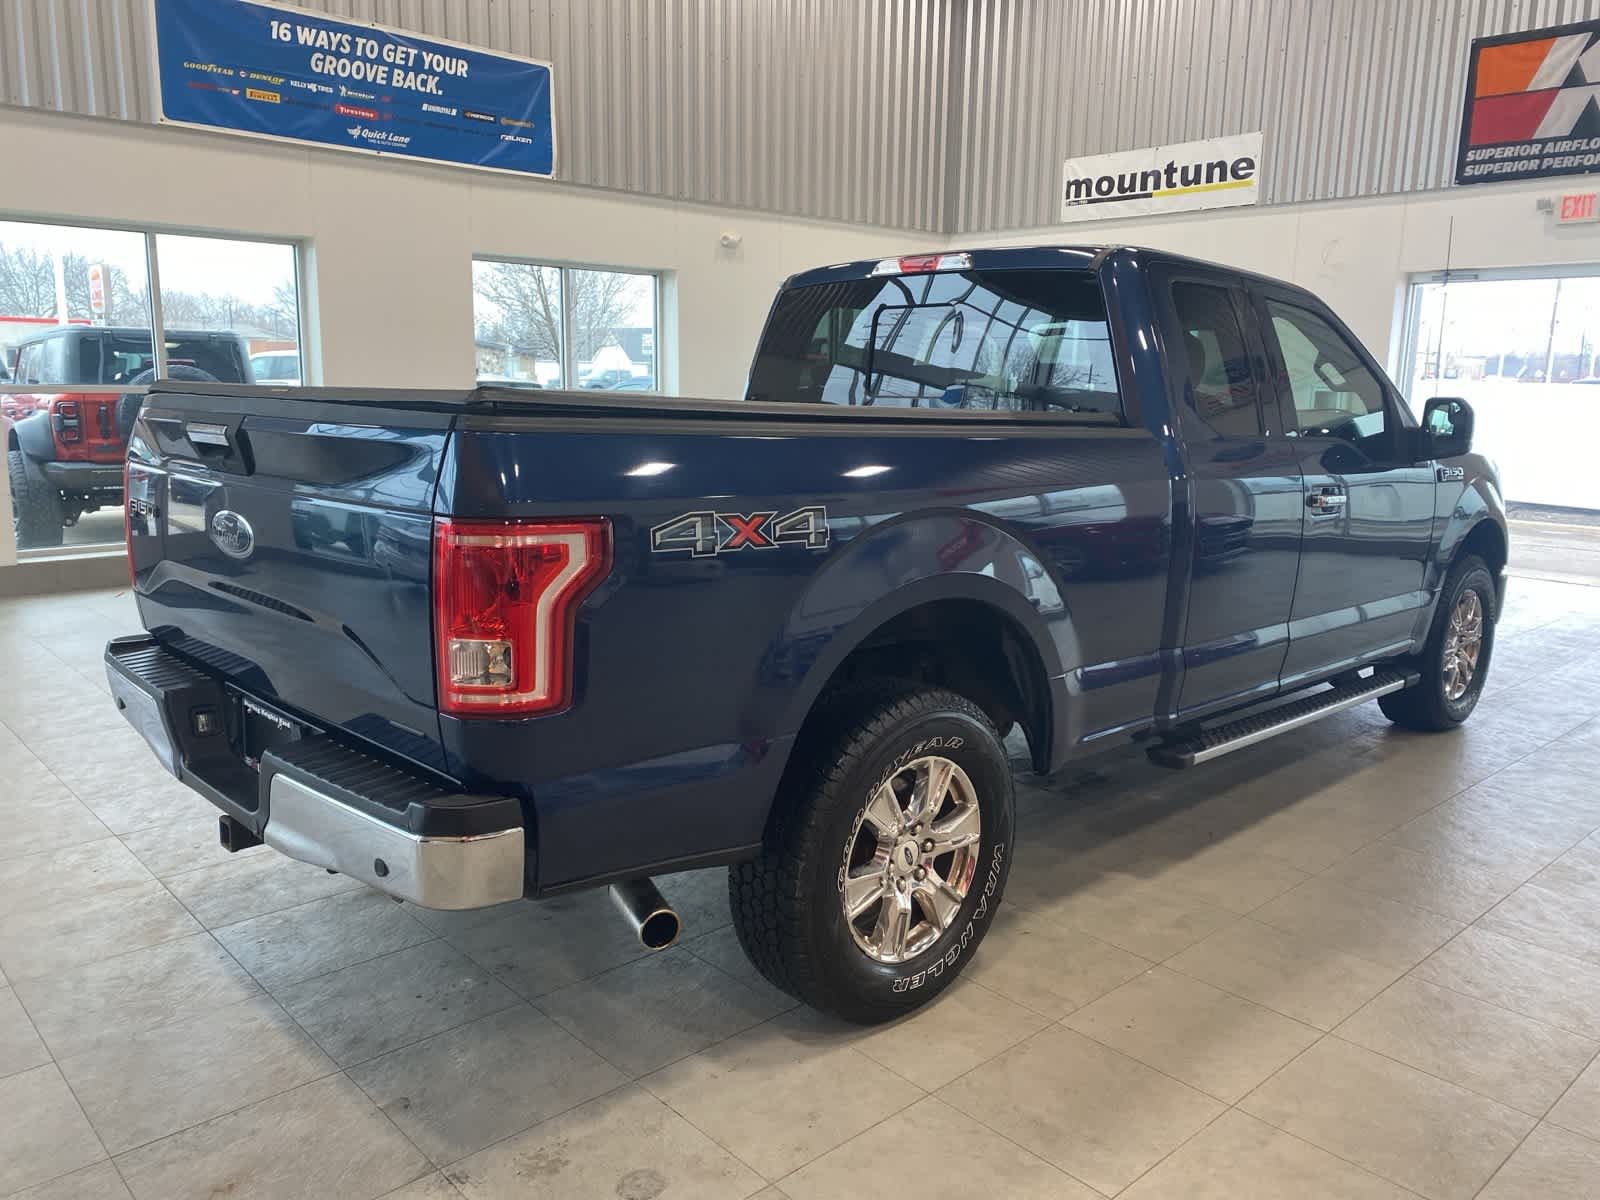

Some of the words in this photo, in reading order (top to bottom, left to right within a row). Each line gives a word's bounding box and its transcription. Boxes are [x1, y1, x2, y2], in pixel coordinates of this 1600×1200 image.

[270, 20, 292, 42] 16
[296, 26, 352, 54] WAYS
[355, 37, 379, 59] TO
[382, 43, 418, 67] GET
[422, 51, 469, 78] YOUR
[183, 61, 234, 76] GOODYEAR
[310, 52, 389, 85] GROOVE
[392, 70, 444, 96] BACK.
[249, 72, 286, 85] DUNLOP
[361, 128, 387, 140] Quick
[388, 132, 411, 144] Lane
[500, 133, 533, 144] FALKEN
[1466, 143, 1542, 162] SUPERIOR
[1463, 159, 1539, 176] SUPERIOR
[1065, 156, 1256, 200] mountune
[1559, 193, 1597, 222] EXIT
[892, 843, 1005, 993] WRANGLER
